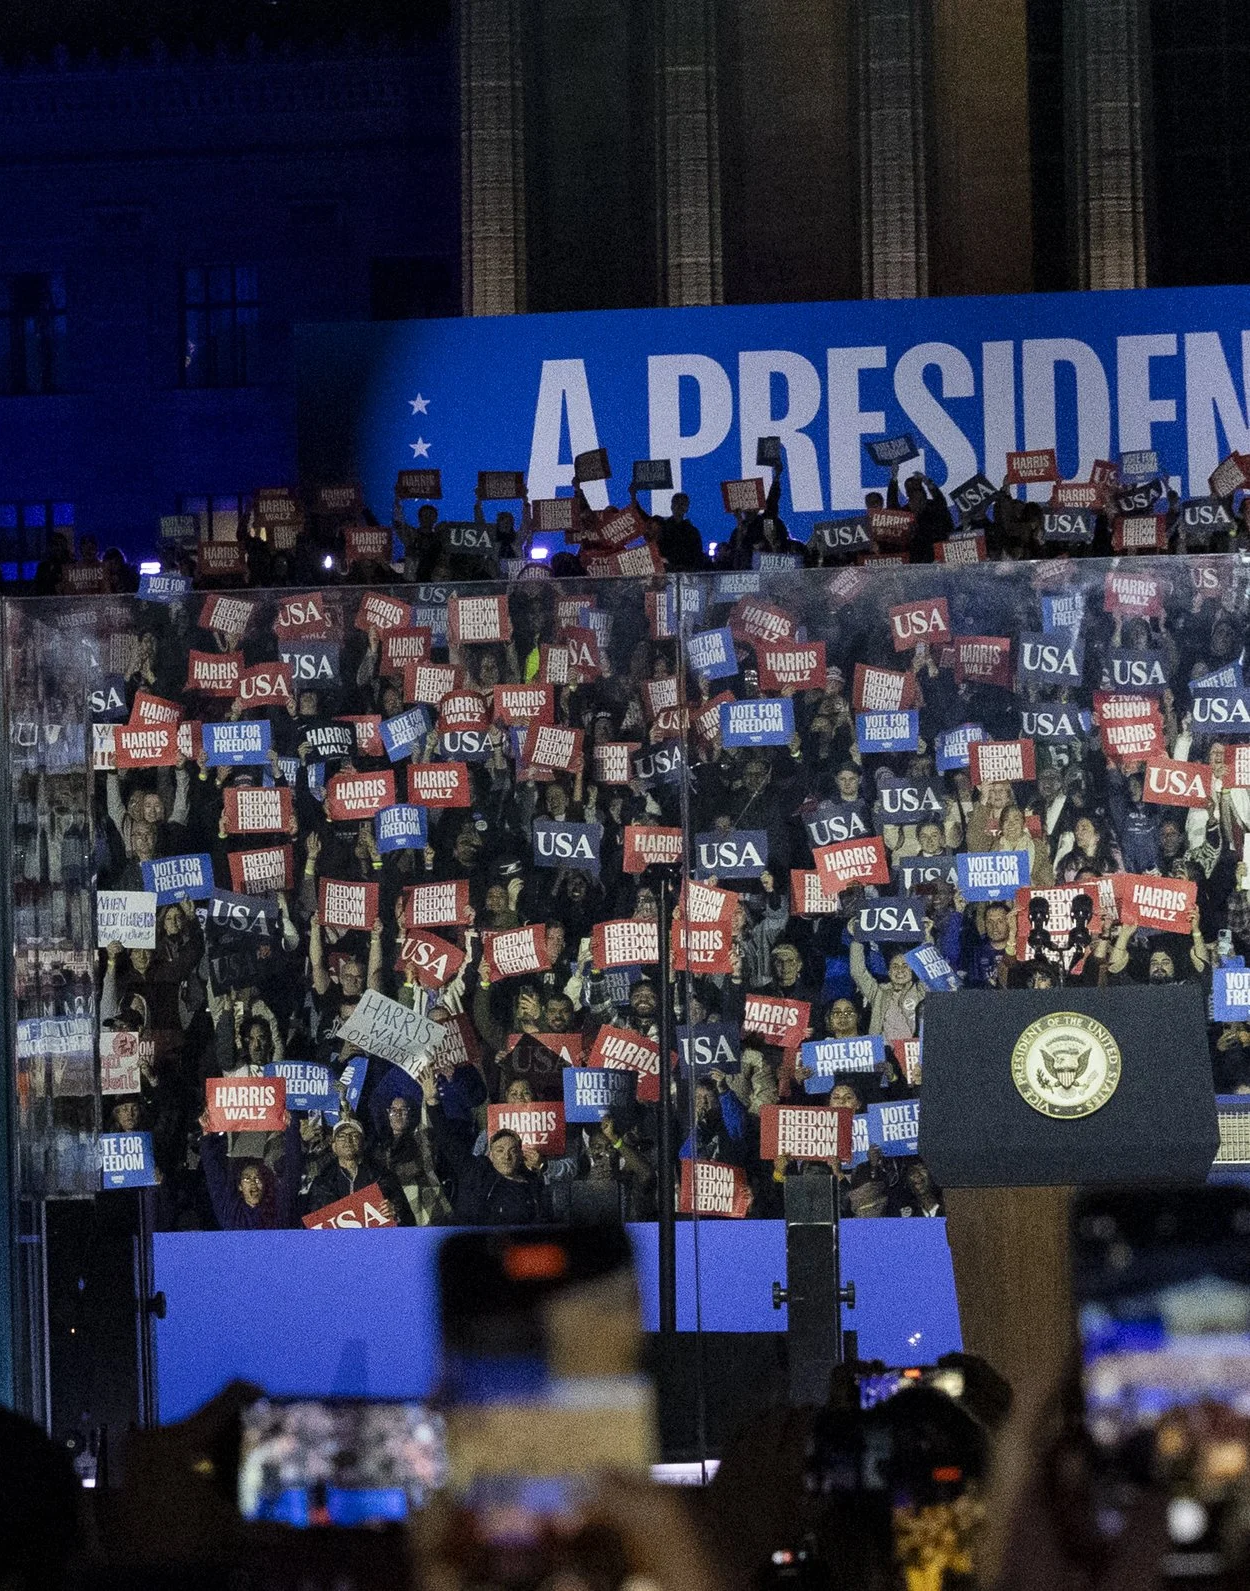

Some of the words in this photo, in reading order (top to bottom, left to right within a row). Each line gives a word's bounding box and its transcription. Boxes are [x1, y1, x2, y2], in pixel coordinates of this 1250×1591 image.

[527, 358, 610, 519] A
[1012, 455, 1050, 471] HARRIS
[1018, 469, 1045, 478] WALZ
[1043, 510, 1087, 534] USA
[1184, 502, 1230, 526] USA
[824, 524, 869, 548] USA
[459, 599, 498, 613] FREEDOM
[459, 613, 499, 626] FREEDOM
[893, 608, 947, 639] USA
[459, 626, 499, 639] FREEDOM
[766, 651, 817, 671] HARRIS
[1022, 644, 1079, 676] USA
[193, 661, 238, 680] HARRIS
[775, 670, 811, 682] WALZ
[1113, 660, 1166, 685] USA
[199, 679, 233, 690] WALZ
[239, 675, 290, 699] USA
[502, 690, 546, 707] HARRIS
[509, 706, 540, 717] WALZ
[730, 706, 758, 719] VOTE
[759, 703, 782, 717] FOR
[1193, 698, 1250, 723] USA
[729, 717, 783, 733] FREEDOM
[865, 715, 888, 728] VOTE
[890, 713, 909, 726] FOR
[1022, 712, 1075, 735] USA
[121, 730, 168, 749] HARRIS
[213, 726, 238, 739] VOTE
[240, 725, 261, 738] FOR
[307, 725, 352, 746] HARRIS
[865, 726, 909, 740] FREEDOM
[1107, 724, 1156, 744] HARRIS
[213, 738, 262, 752] FREEDOM
[317, 743, 350, 756] WALZ
[443, 732, 495, 753] USA
[1116, 741, 1152, 755] WALZ
[129, 747, 162, 759] WALZ
[978, 744, 1021, 758] FREEDOM
[979, 757, 1022, 770] FREEDOM
[413, 770, 458, 789] HARRIS
[979, 770, 1022, 782] FREEDOM
[1150, 768, 1208, 798] USA
[237, 791, 281, 804] FREEDOM
[336, 779, 386, 801] HARRIS
[420, 788, 453, 800] WALZ
[344, 798, 379, 810] WALZ
[881, 787, 942, 813] USA
[237, 804, 281, 817] FREEDOM
[380, 809, 401, 824] VOTE
[402, 808, 419, 822] FOR
[237, 816, 282, 830] FREEDOM
[380, 822, 421, 837] FREEDOM
[808, 812, 866, 846] USA
[537, 831, 596, 859] USA
[634, 833, 683, 853] HARRIS
[643, 852, 678, 864] WALZ
[699, 841, 765, 869] USA
[824, 846, 877, 871] HARRIS
[967, 856, 993, 871] VOTE
[995, 855, 1018, 870] FOR
[835, 865, 873, 881] WALZ
[968, 870, 1019, 886] FREEDOM
[1132, 884, 1187, 910] HARRIS
[212, 900, 271, 937] USA
[860, 907, 920, 932] USA
[1139, 907, 1177, 922] WALZ
[604, 923, 658, 936] FREEDOM
[605, 936, 659, 949] FREEDOM
[400, 937, 448, 980] USA
[605, 948, 659, 963] FREEDOM
[362, 994, 435, 1045] HARRIS
[1047, 1017, 1060, 1027] OF
[1064, 1017, 1083, 1026] THE
[369, 1022, 413, 1052] WALZ
[1087, 1020, 1119, 1064] UNITED
[815, 1044, 846, 1060] VOTE
[848, 1041, 873, 1056] FOR
[1013, 1023, 1043, 1086] PRESIDENT
[215, 1086, 275, 1107] HARRIS
[1085, 1069, 1117, 1112] STATES
[1023, 1087, 1051, 1113] VICE
[224, 1107, 266, 1120] WALZ
[779, 1110, 838, 1125] FREEDOM
[779, 1125, 838, 1141] FREEDOM
[778, 1140, 838, 1157] FREEDOM
